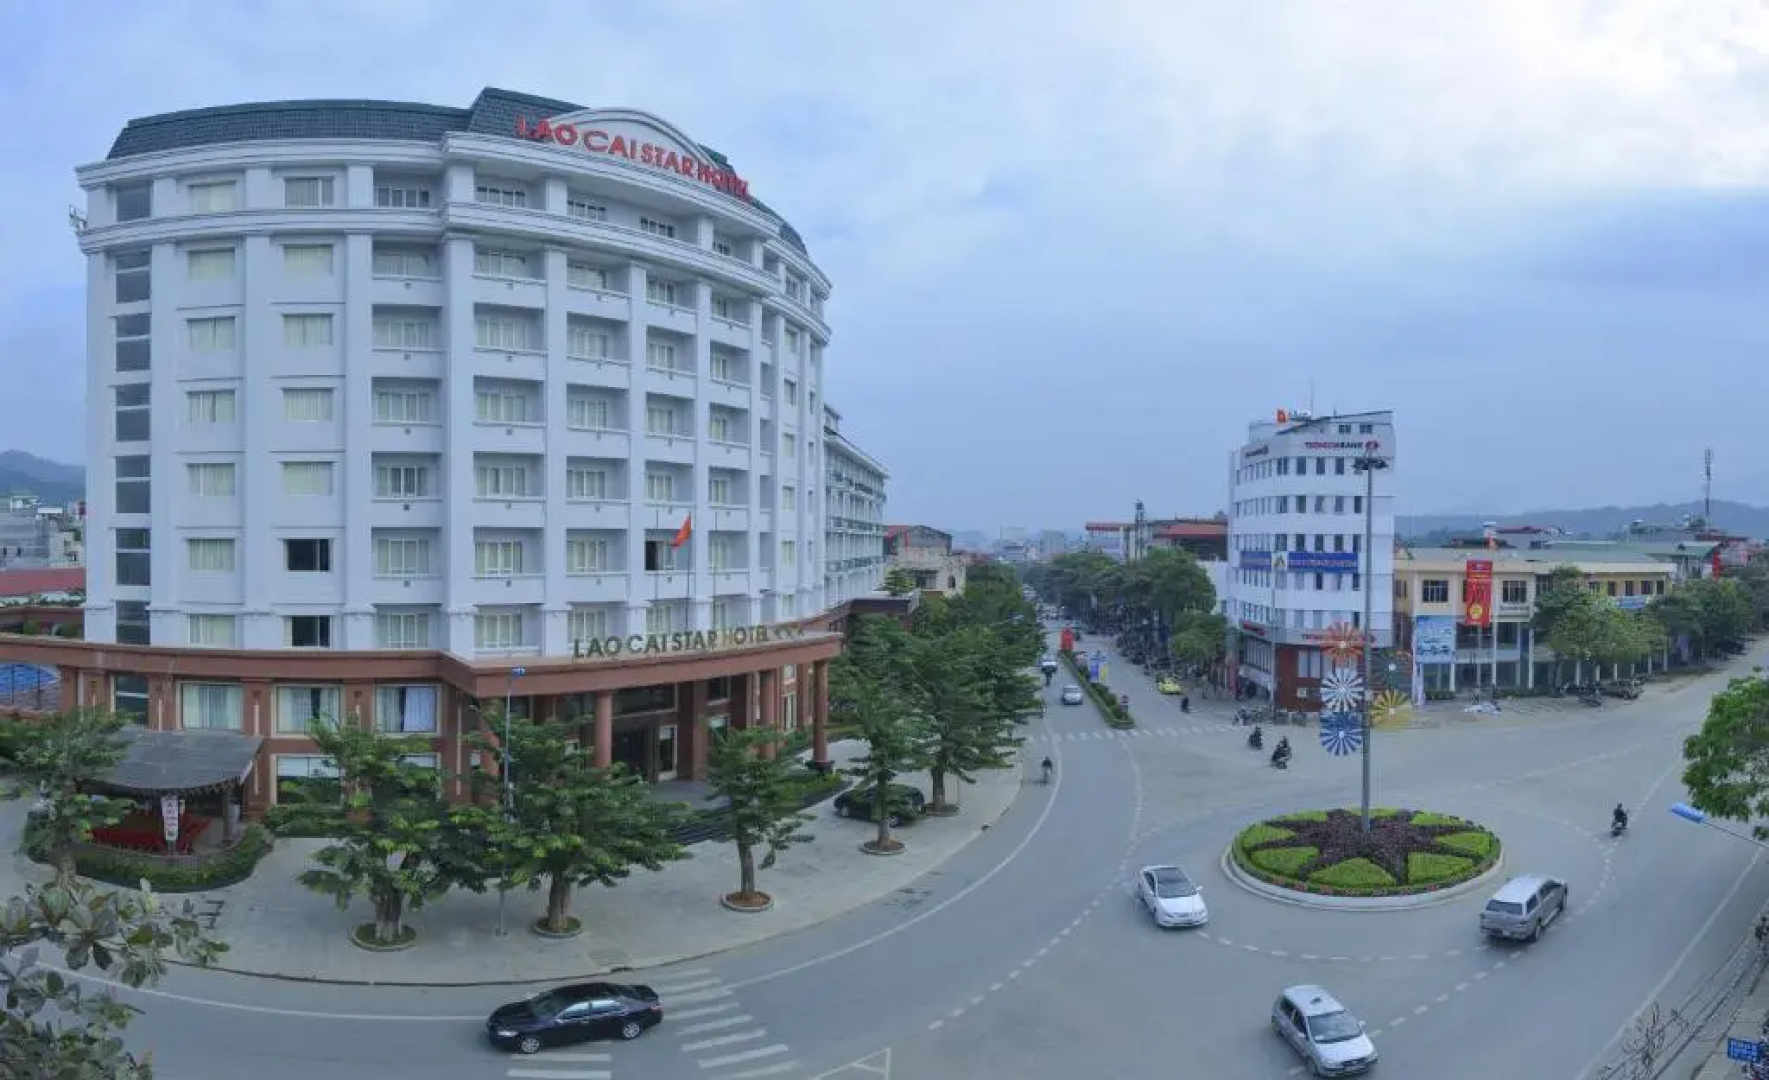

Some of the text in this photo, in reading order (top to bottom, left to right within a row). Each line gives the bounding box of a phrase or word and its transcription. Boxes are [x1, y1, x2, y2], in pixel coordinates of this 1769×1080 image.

[515, 114, 578, 146] LAO
[583, 130, 637, 160] CAI
[641, 143, 695, 177] STAR
[573, 635, 622, 659] LAO
[628, 632, 668, 654] CAI
[672, 628, 718, 651] STAR
